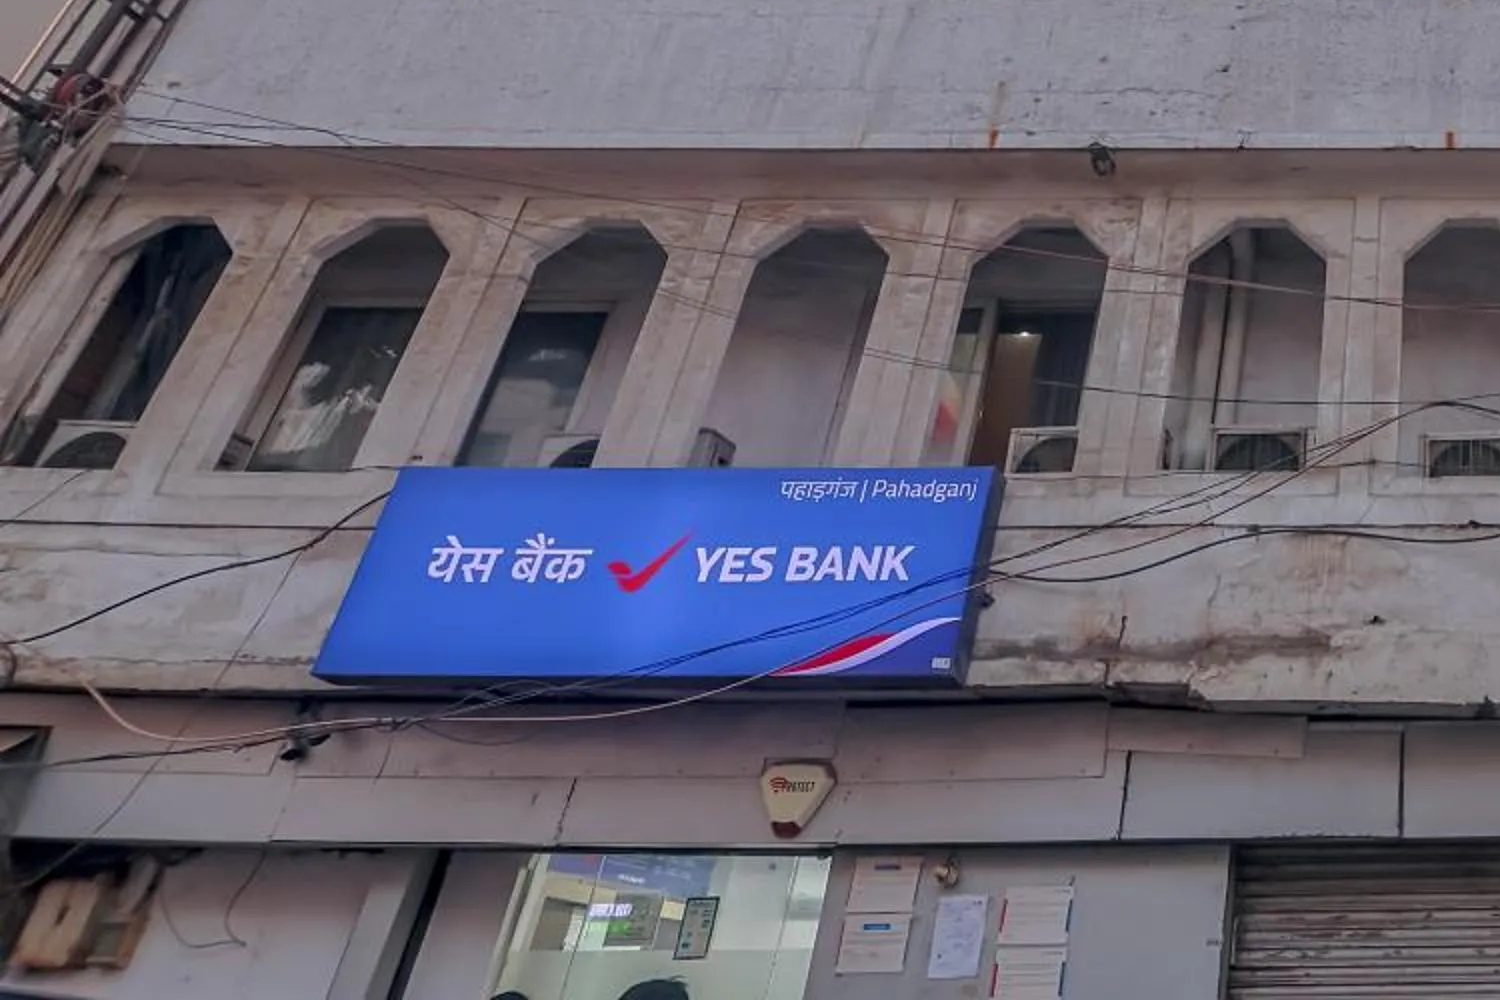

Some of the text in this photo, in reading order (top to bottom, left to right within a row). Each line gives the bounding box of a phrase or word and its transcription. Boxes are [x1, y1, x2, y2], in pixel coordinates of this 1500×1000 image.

[872, 479, 978, 503] Pahadganj
[427, 532, 593, 583] येस बैंक
[696, 545, 915, 583] YES BANK
